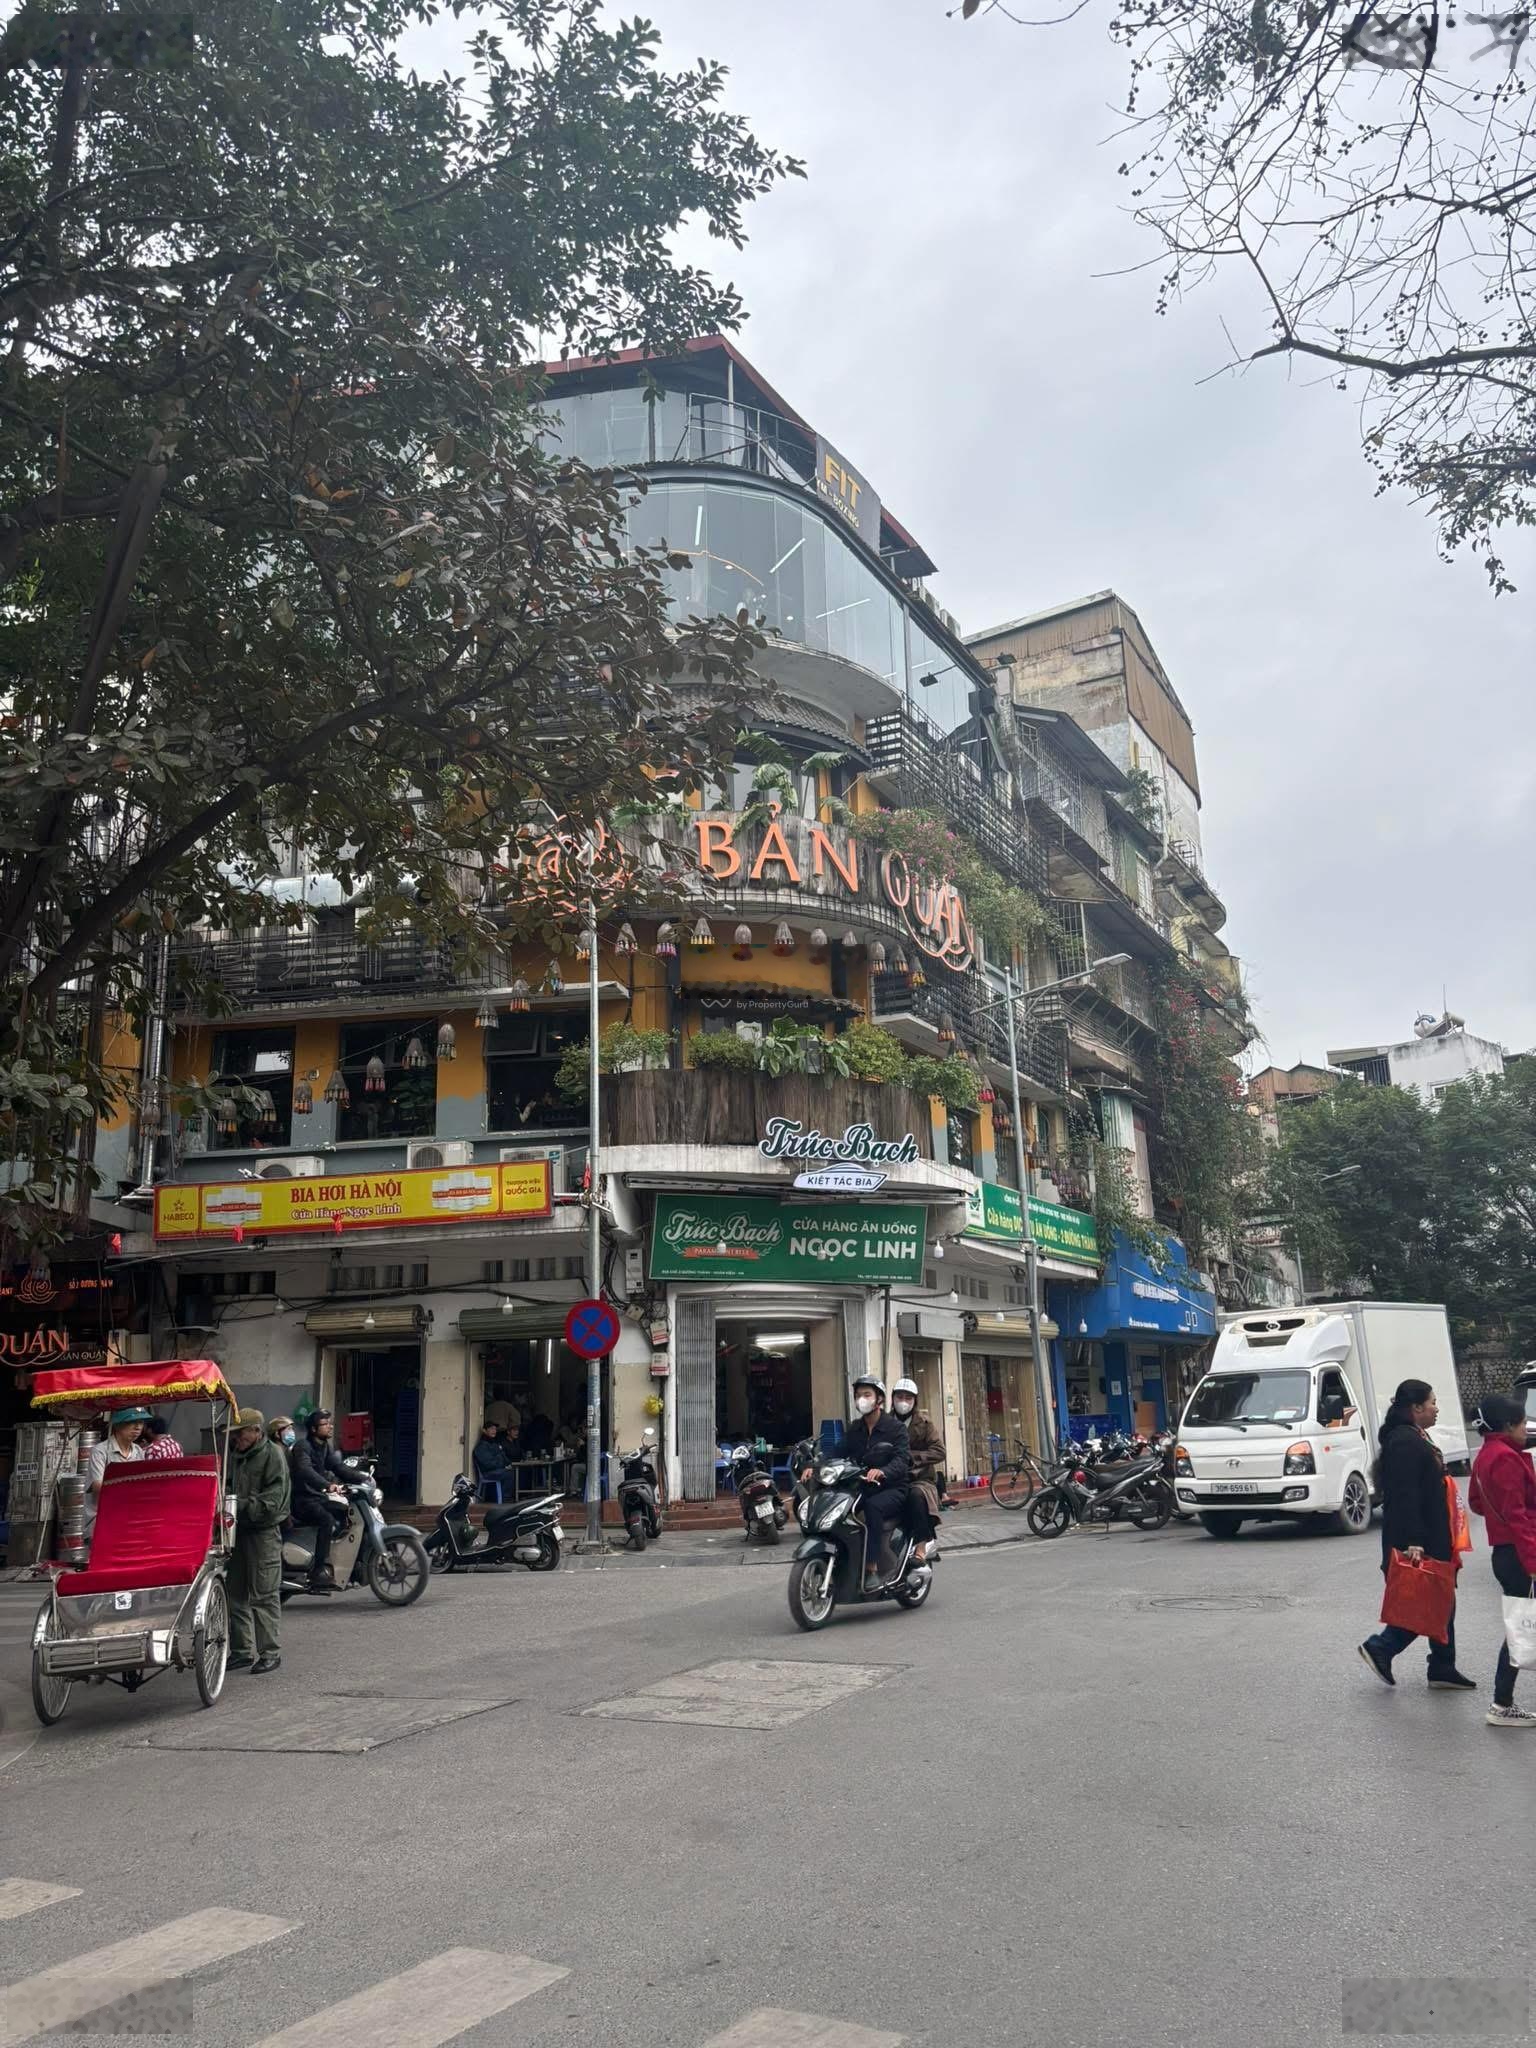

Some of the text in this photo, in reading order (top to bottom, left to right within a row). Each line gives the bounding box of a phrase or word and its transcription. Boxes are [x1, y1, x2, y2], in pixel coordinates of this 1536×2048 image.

[825, 454, 862, 510] FIT
[833, 496, 860, 528] BOXING
[695, 800, 975, 971] BẢN QUÁN
[759, 1117, 919, 1167] Trúc Bạch
[291, 1179, 402, 1203] BIA HƠI HÀ NỘI
[833, 1176, 853, 1186] TÁC
[855, 1178, 873, 1187] BIA
[163, 1212, 195, 1222] HABECO
[291, 1208, 313, 1220] Cửa
[345, 1206, 374, 1219] Ngọc
[375, 1203, 402, 1215] Linh
[664, 1211, 782, 1246] Trúc Bạch
[792, 1216, 917, 1235] CỬA HÀNG ĂN UỐNG
[789, 1237, 917, 1262] NGỌC LINH
